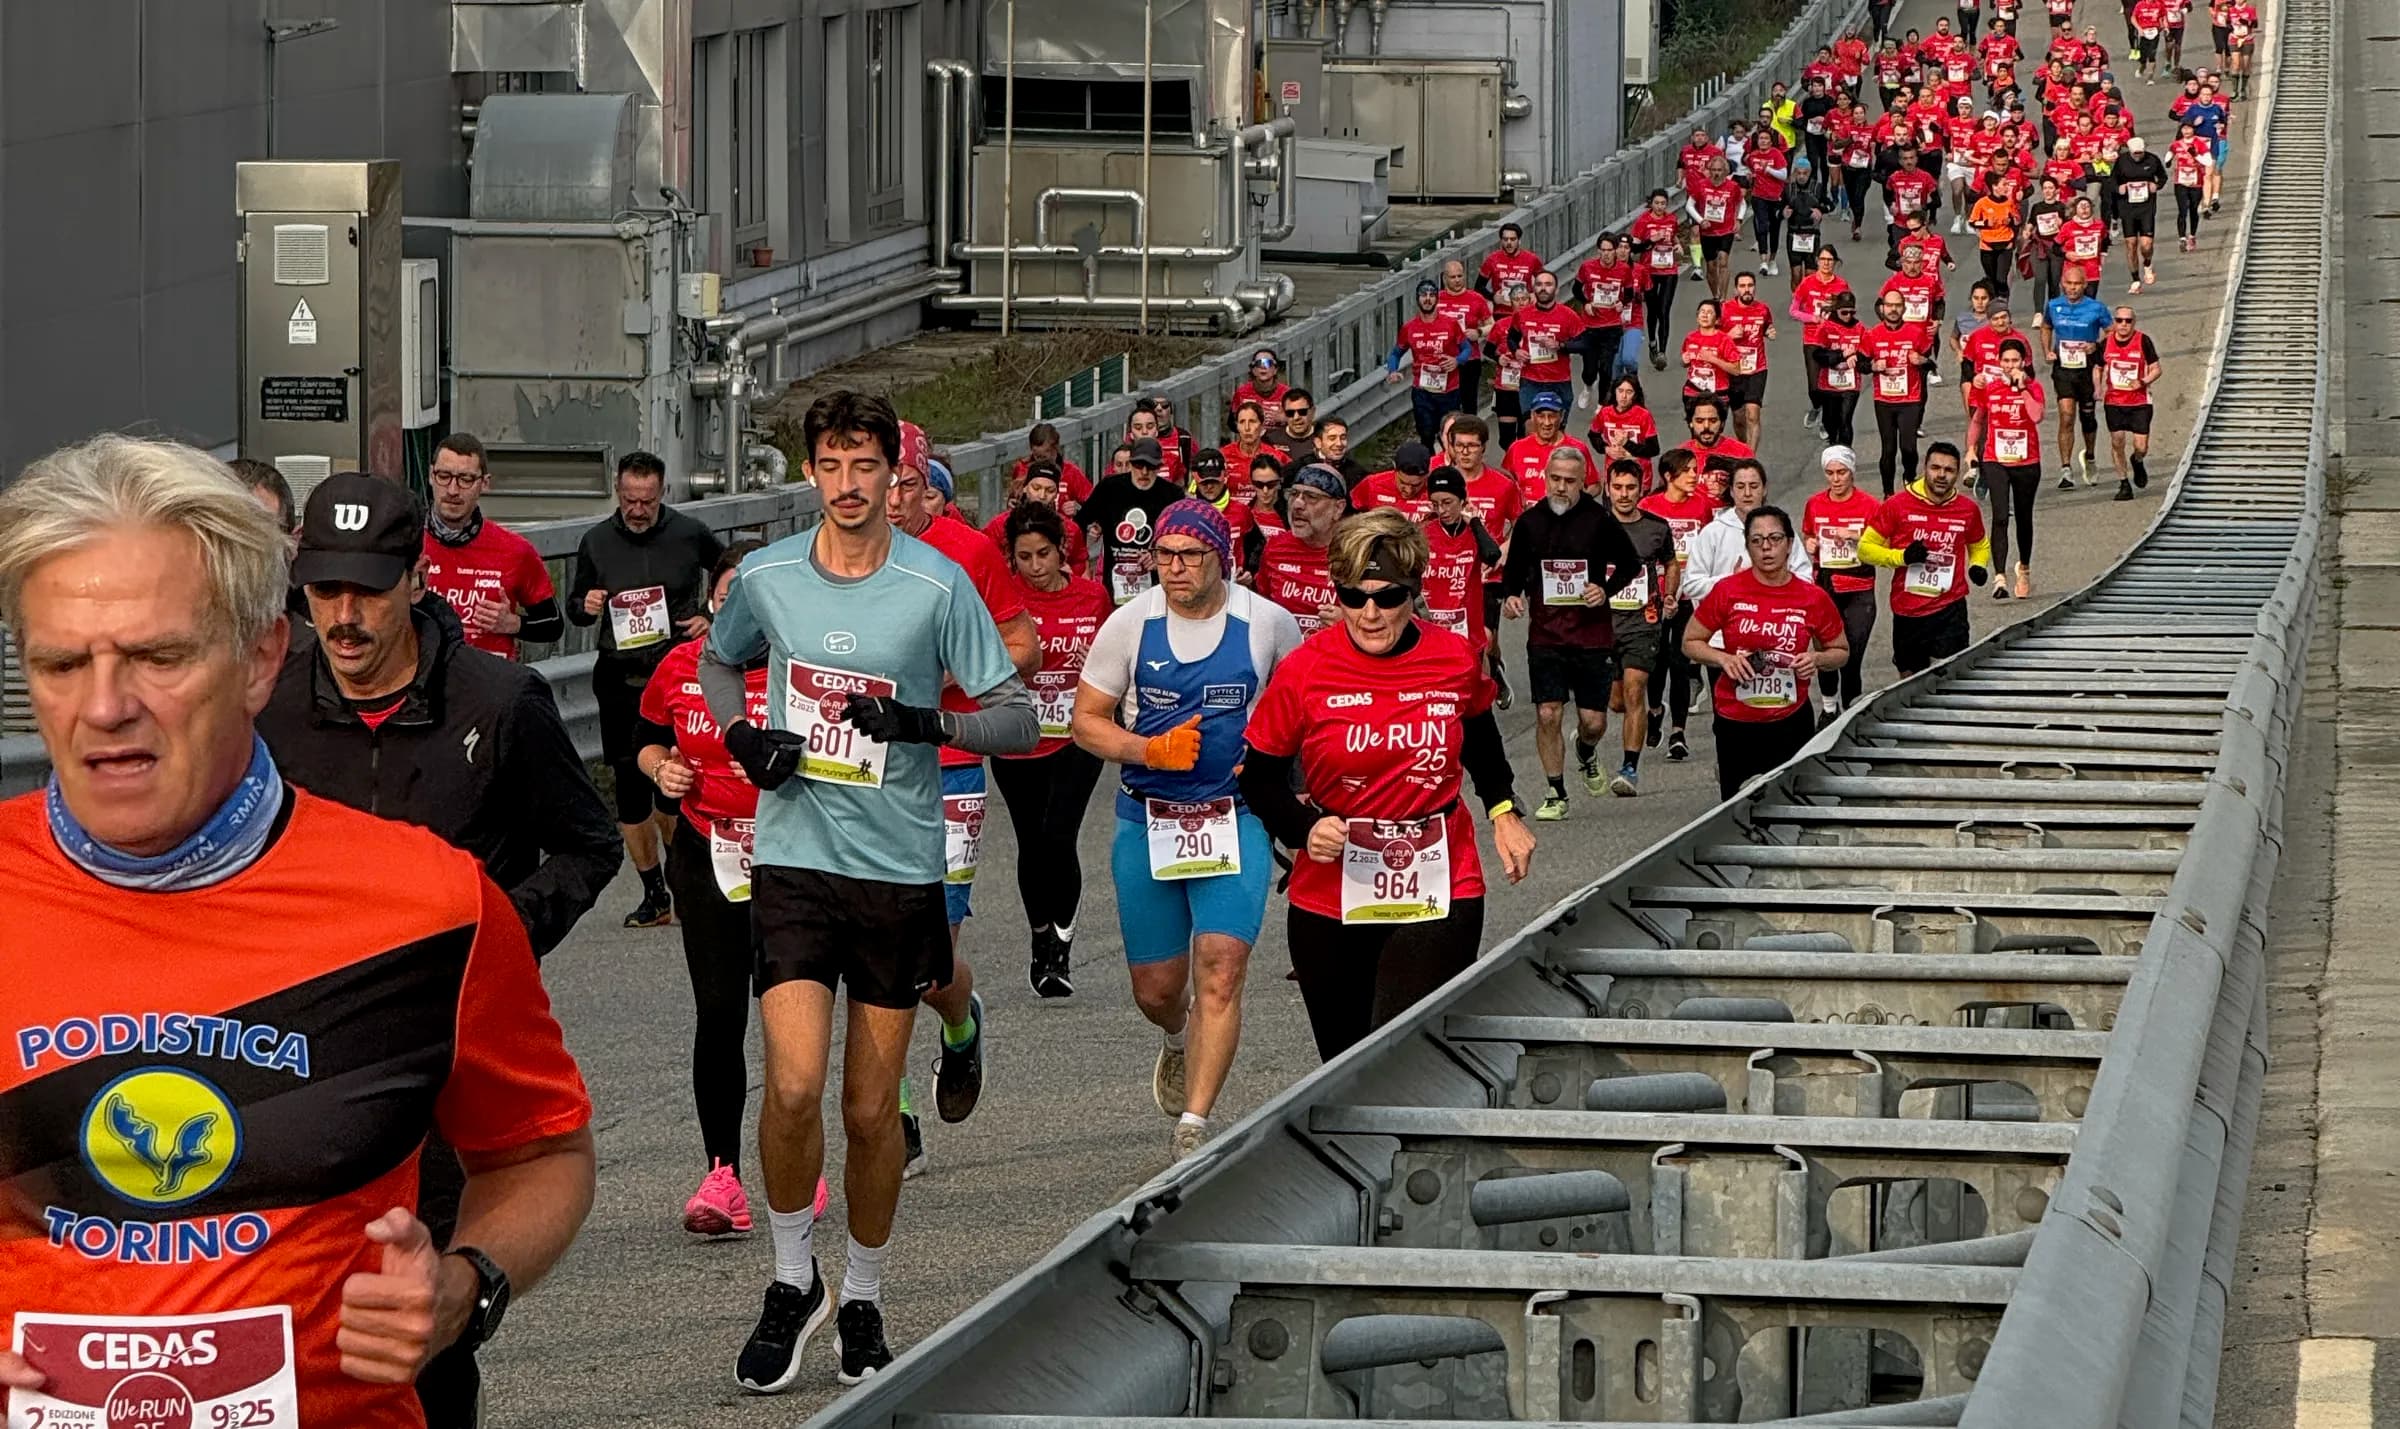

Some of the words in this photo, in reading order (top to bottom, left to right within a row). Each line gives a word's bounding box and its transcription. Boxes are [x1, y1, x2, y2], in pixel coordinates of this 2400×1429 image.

[1437, 566, 1466, 579] RUN
[1282, 581, 1302, 598] We
[1302, 586, 1338, 605] RUN
[1449, 578, 1466, 590] 25
[1556, 582, 1575, 595] 610
[629, 616, 654, 634] 882
[1739, 618, 1761, 634] We
[1761, 622, 1798, 637] RUN
[1774, 637, 1798, 652] 25
[811, 672, 868, 694] CEDAS
[1032, 674, 1067, 684] CEDAS
[1752, 677, 1783, 694] 1738
[1209, 688, 1241, 696] OTTICA
[1326, 692, 1374, 708] CEDAS
[1398, 691, 1424, 702] base
[686, 709, 714, 736] We
[808, 722, 854, 759] 601
[1346, 723, 1385, 753] We
[1387, 719, 1447, 751] RUN
[1411, 747, 1449, 772] 25
[1168, 803, 1212, 813] CEDAS
[1174, 832, 1213, 859] 290
[1395, 848, 1414, 858] RUN
[1349, 850, 1358, 863] 2
[1359, 855, 1380, 864] 2025
[1391, 858, 1406, 868] 25
[1373, 871, 1420, 900] 964
[17, 1012, 311, 1079] PODISTICA
[43, 1205, 271, 1264] TORINO
[78, 1329, 219, 1371] CEDAS
[48, 1409, 96, 1421] EDIZIONE
[110, 1398, 139, 1422] We
[139, 1396, 188, 1420] RUN
[210, 1404, 230, 1429] 9
[239, 1398, 276, 1429] 25
